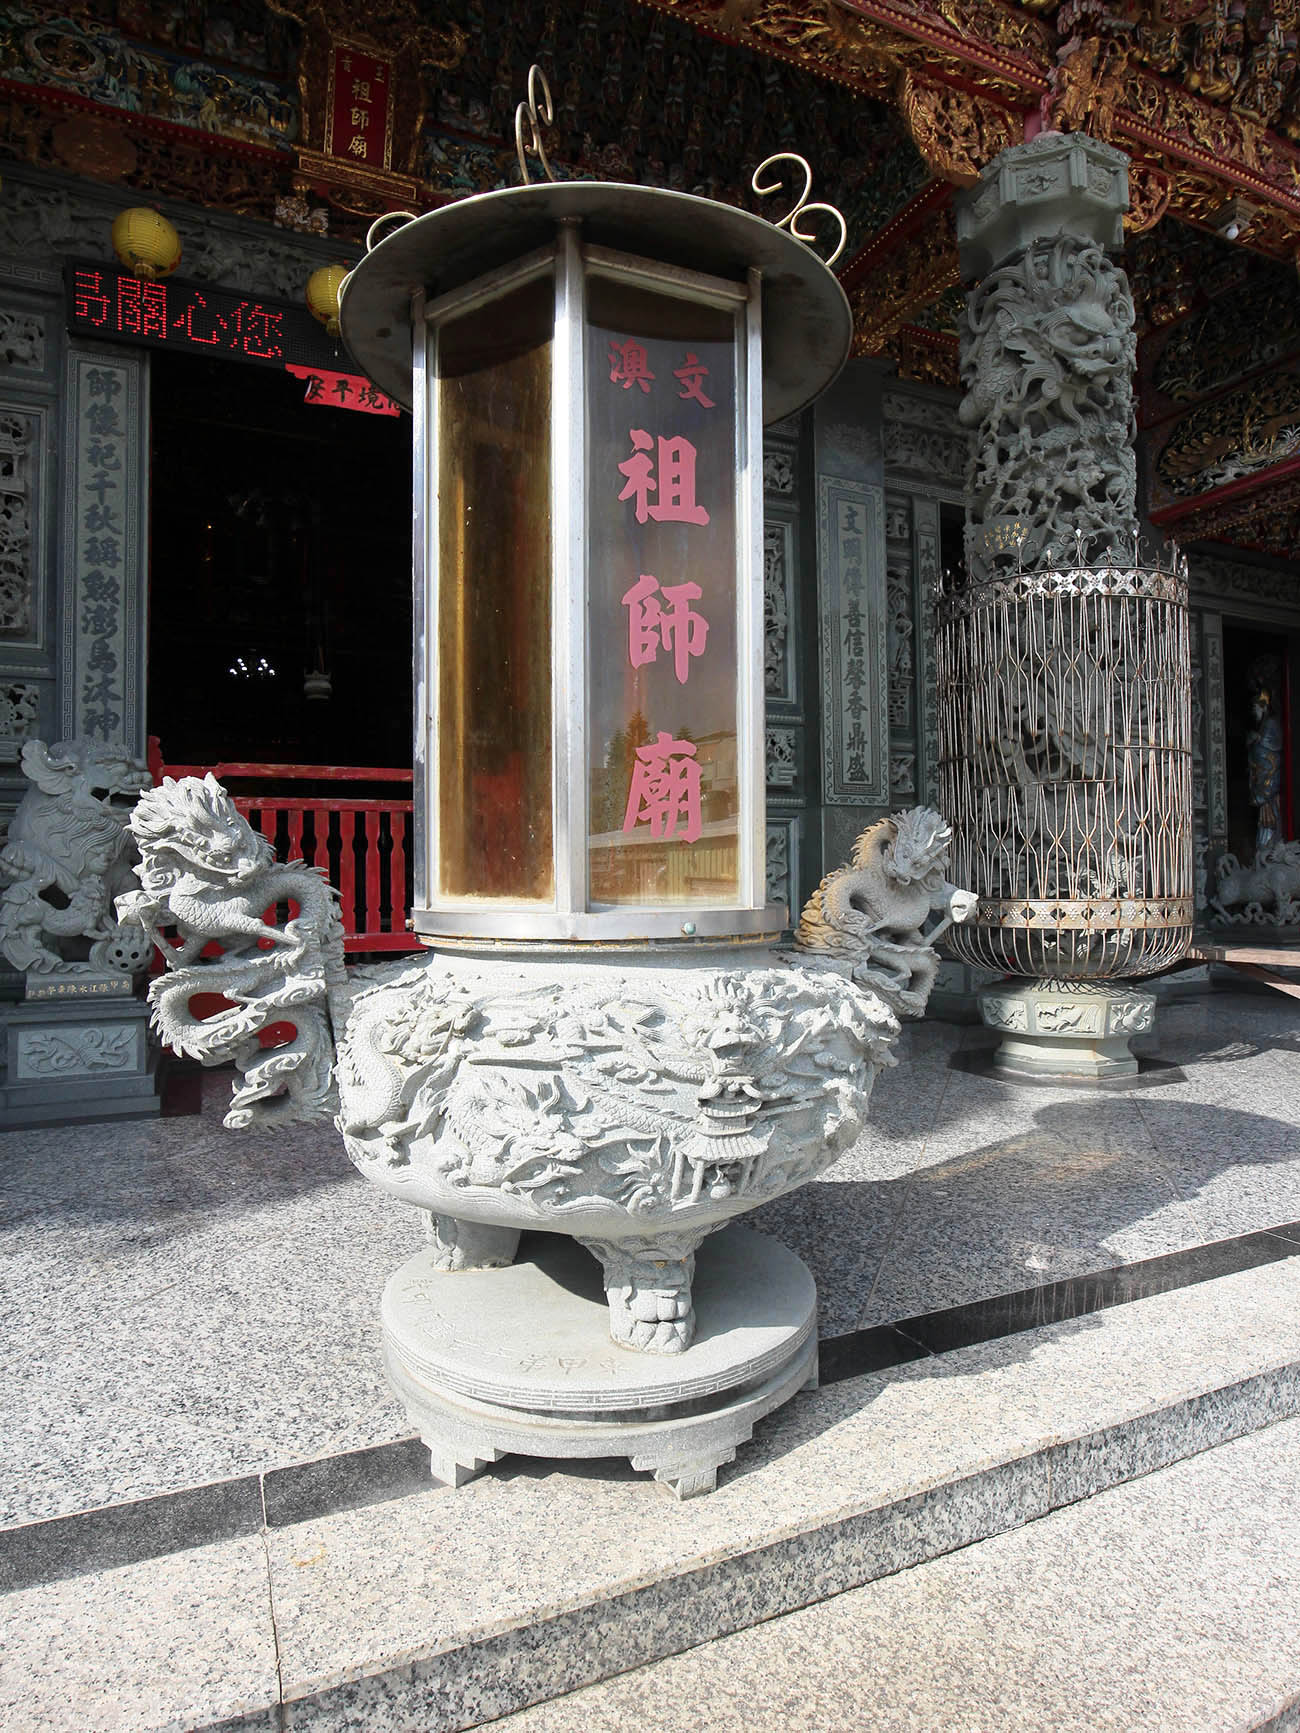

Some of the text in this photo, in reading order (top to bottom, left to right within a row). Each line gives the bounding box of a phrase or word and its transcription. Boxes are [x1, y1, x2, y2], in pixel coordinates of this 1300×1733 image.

[347, 77, 374, 159] 祖師廟
[607, 340, 715, 409] 文澳
[617, 428, 711, 844] 祖師廟
